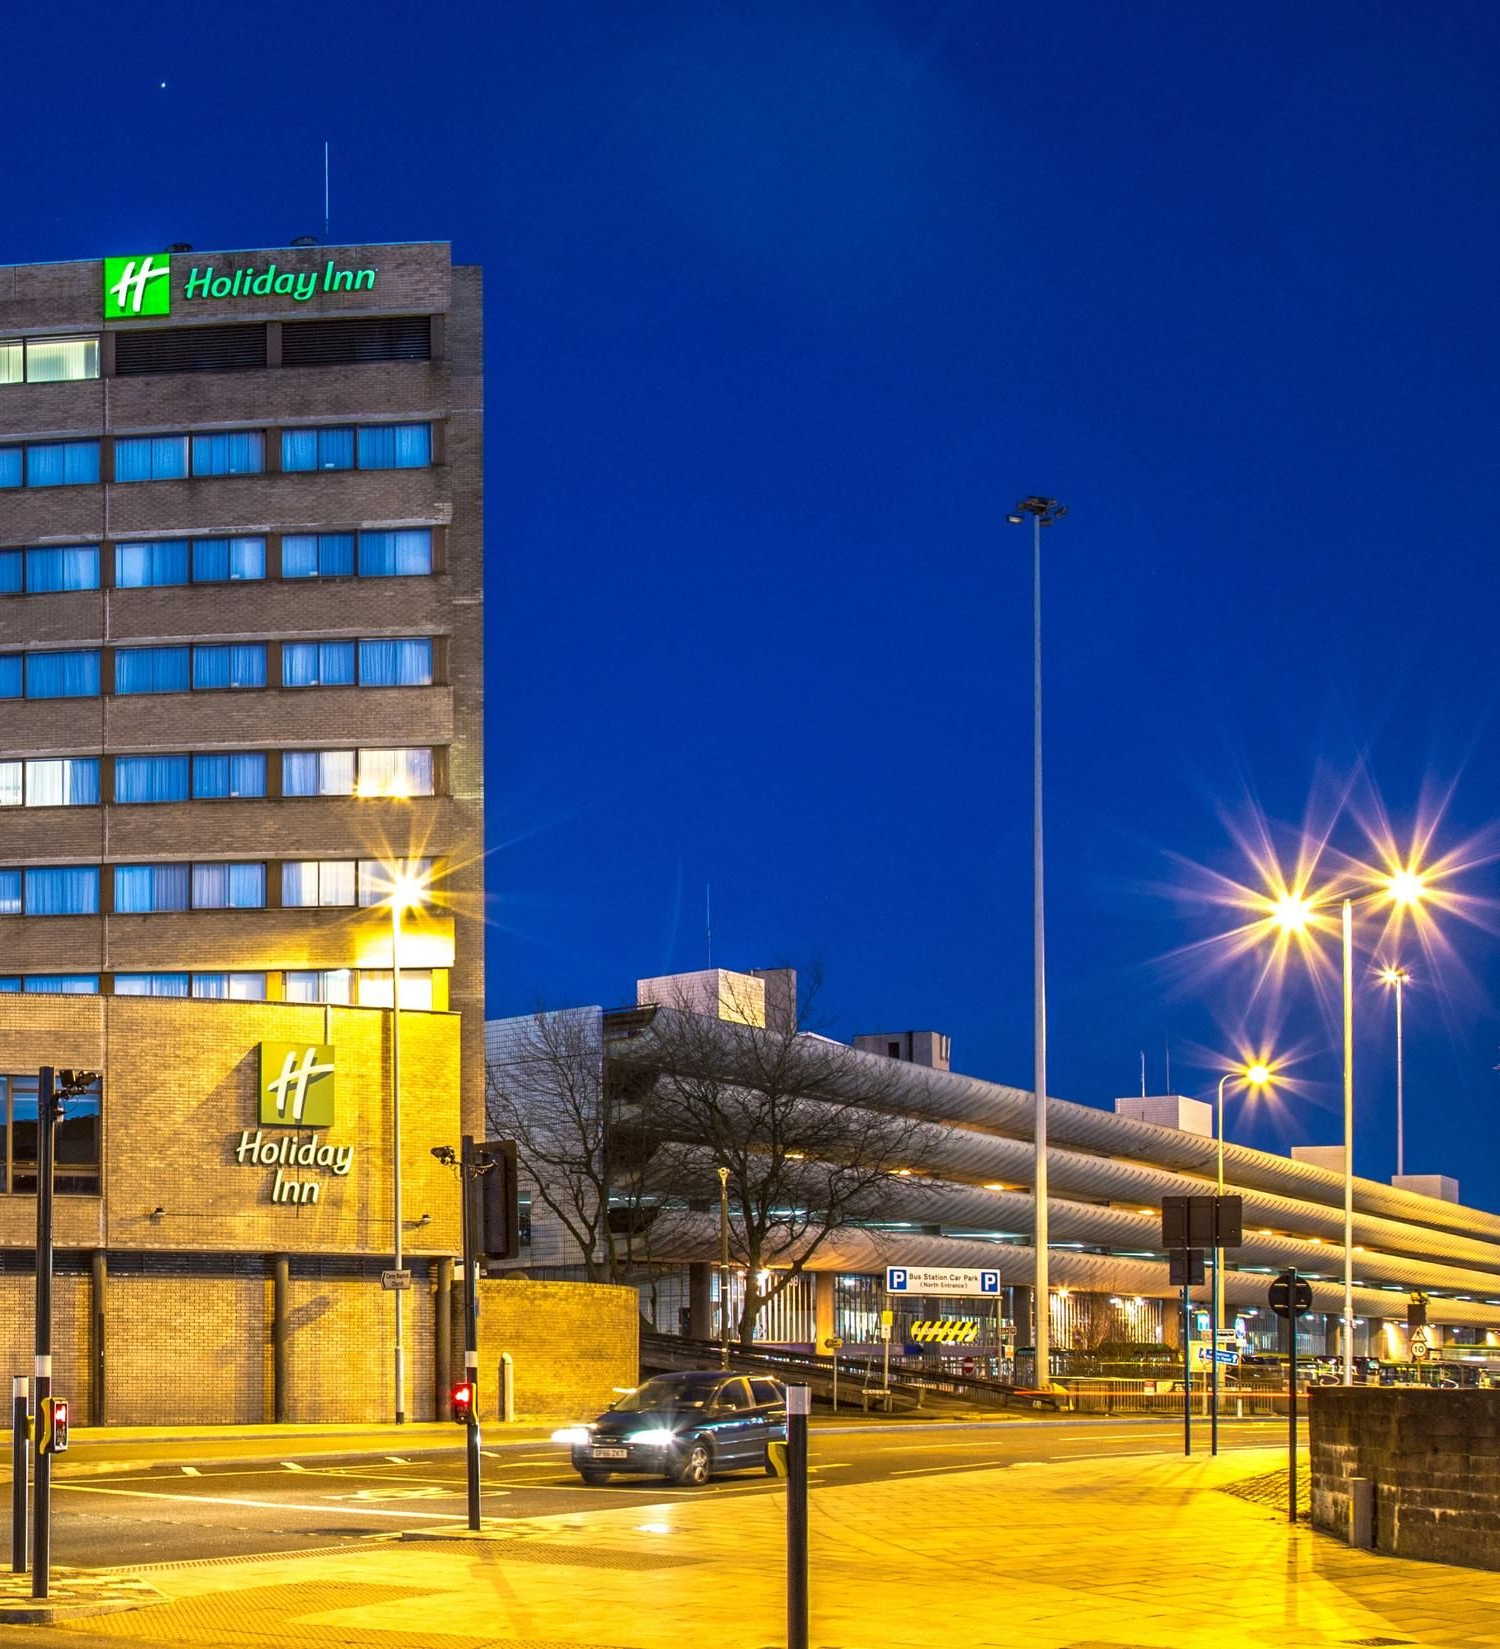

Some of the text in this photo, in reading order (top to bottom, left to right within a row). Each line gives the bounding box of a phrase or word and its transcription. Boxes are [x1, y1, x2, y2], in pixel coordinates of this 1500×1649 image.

[184, 260, 376, 301] Holiday Inn
[236, 1131, 355, 1175] Holiday
[272, 1169, 321, 1204] Inn
[964, 1274, 979, 1282] Park
[1414, 1345, 1424, 1353] 10
